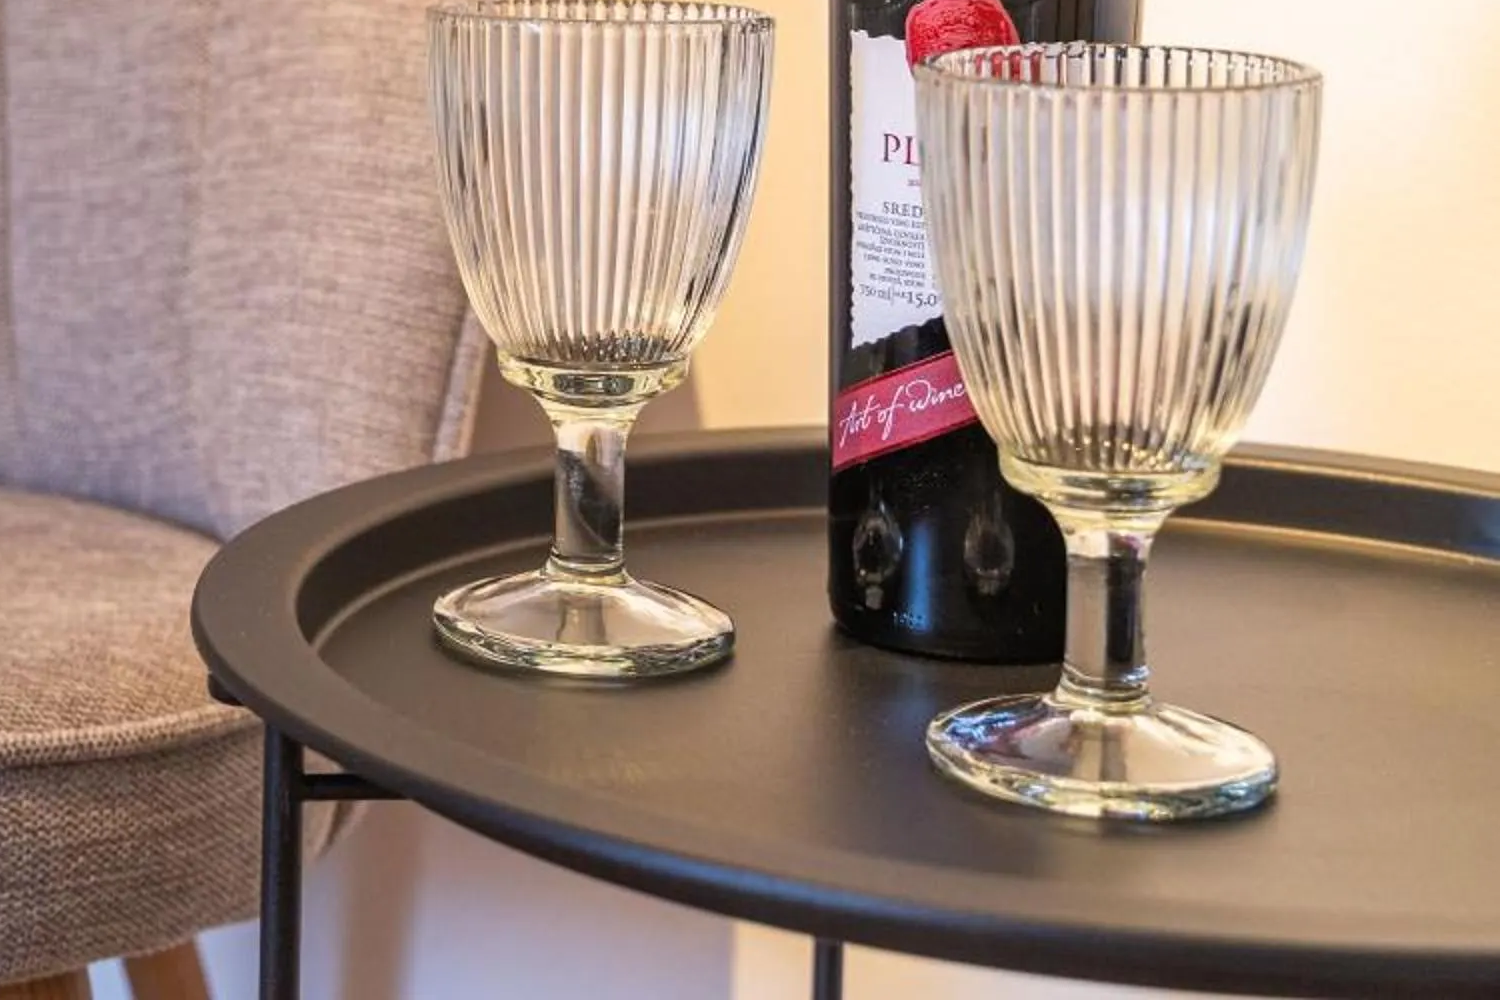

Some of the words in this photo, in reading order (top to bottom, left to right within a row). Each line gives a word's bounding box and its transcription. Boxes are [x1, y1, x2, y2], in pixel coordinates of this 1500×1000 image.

[882, 132, 922, 166] PL
[882, 201, 924, 219] SRED
[839, 395, 881, 448] Art
[877, 385, 904, 441] of
